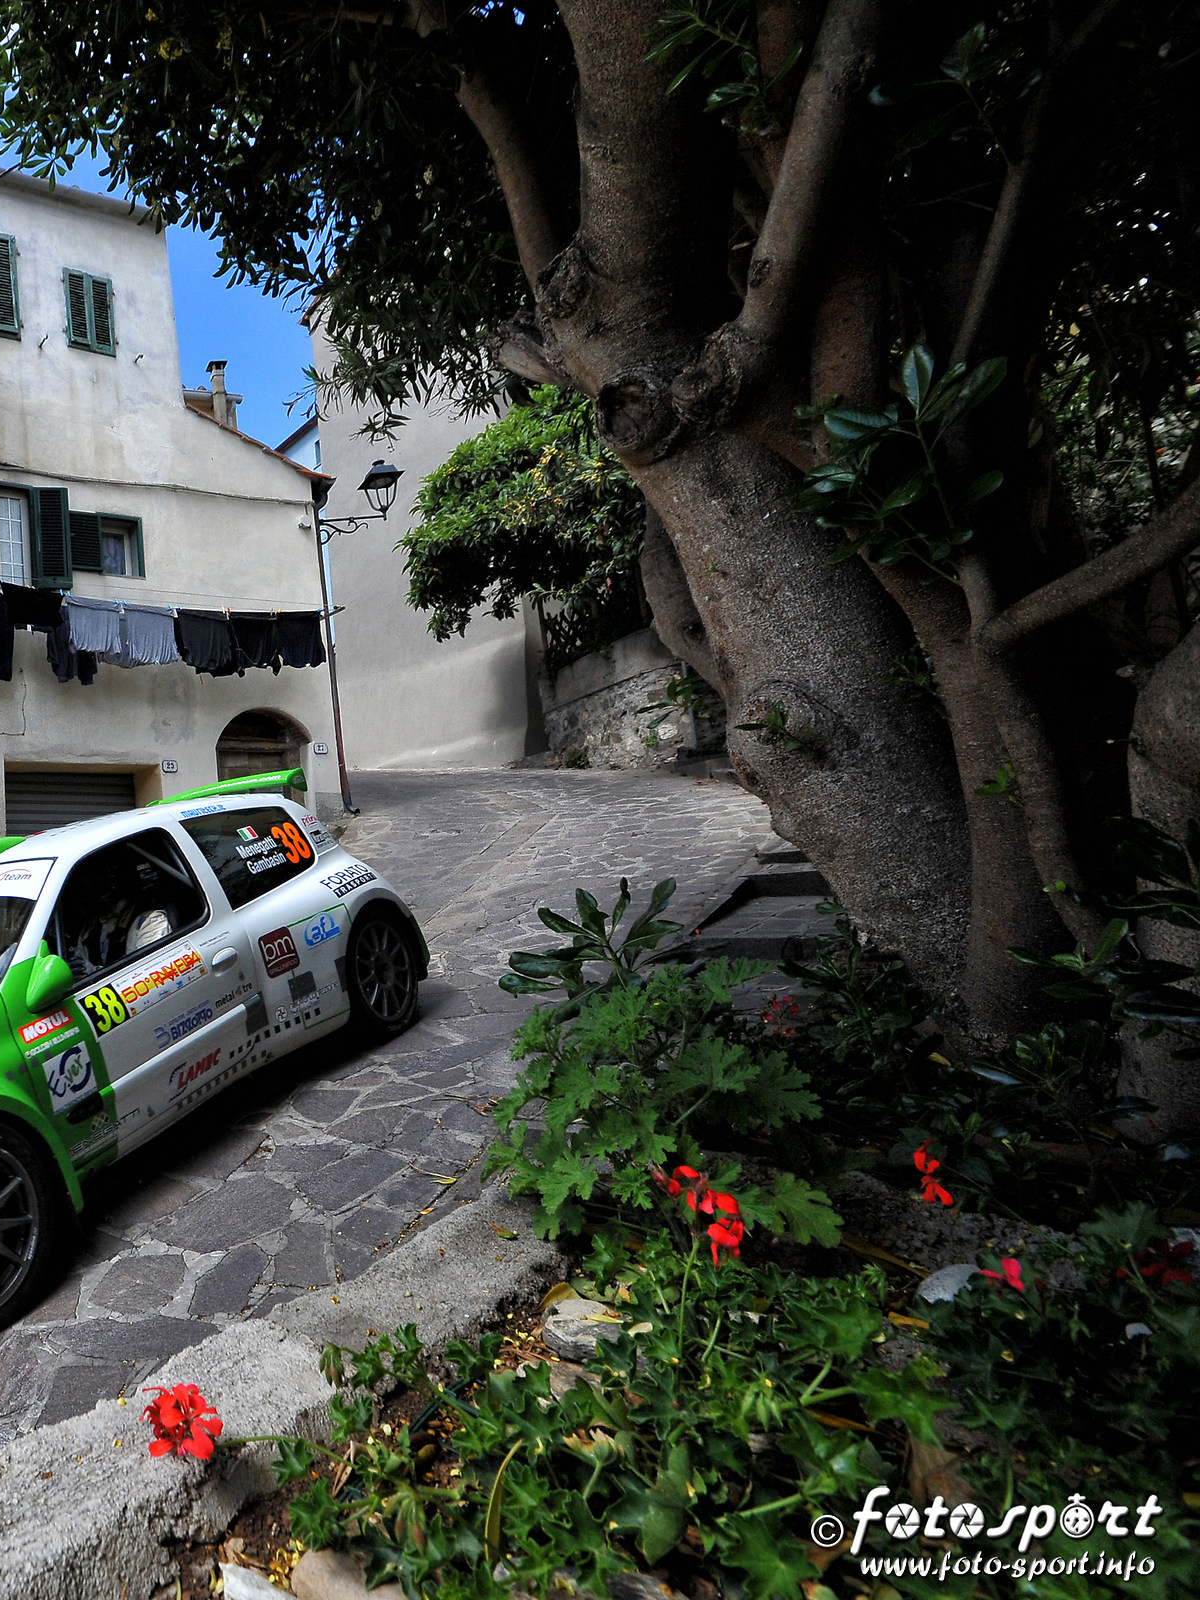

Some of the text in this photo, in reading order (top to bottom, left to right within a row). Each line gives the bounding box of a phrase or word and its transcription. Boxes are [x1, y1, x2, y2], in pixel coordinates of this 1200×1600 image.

[235, 835, 278, 859] Menegatti
[270, 821, 311, 864] 38
[246, 852, 287, 876] Gambasin
[319, 864, 369, 889] FORATO
[260, 935, 294, 962] bm
[215, 982, 253, 1009] metal tre
[84, 986, 126, 1033] 38
[23, 1011, 69, 1042] MOTUL
